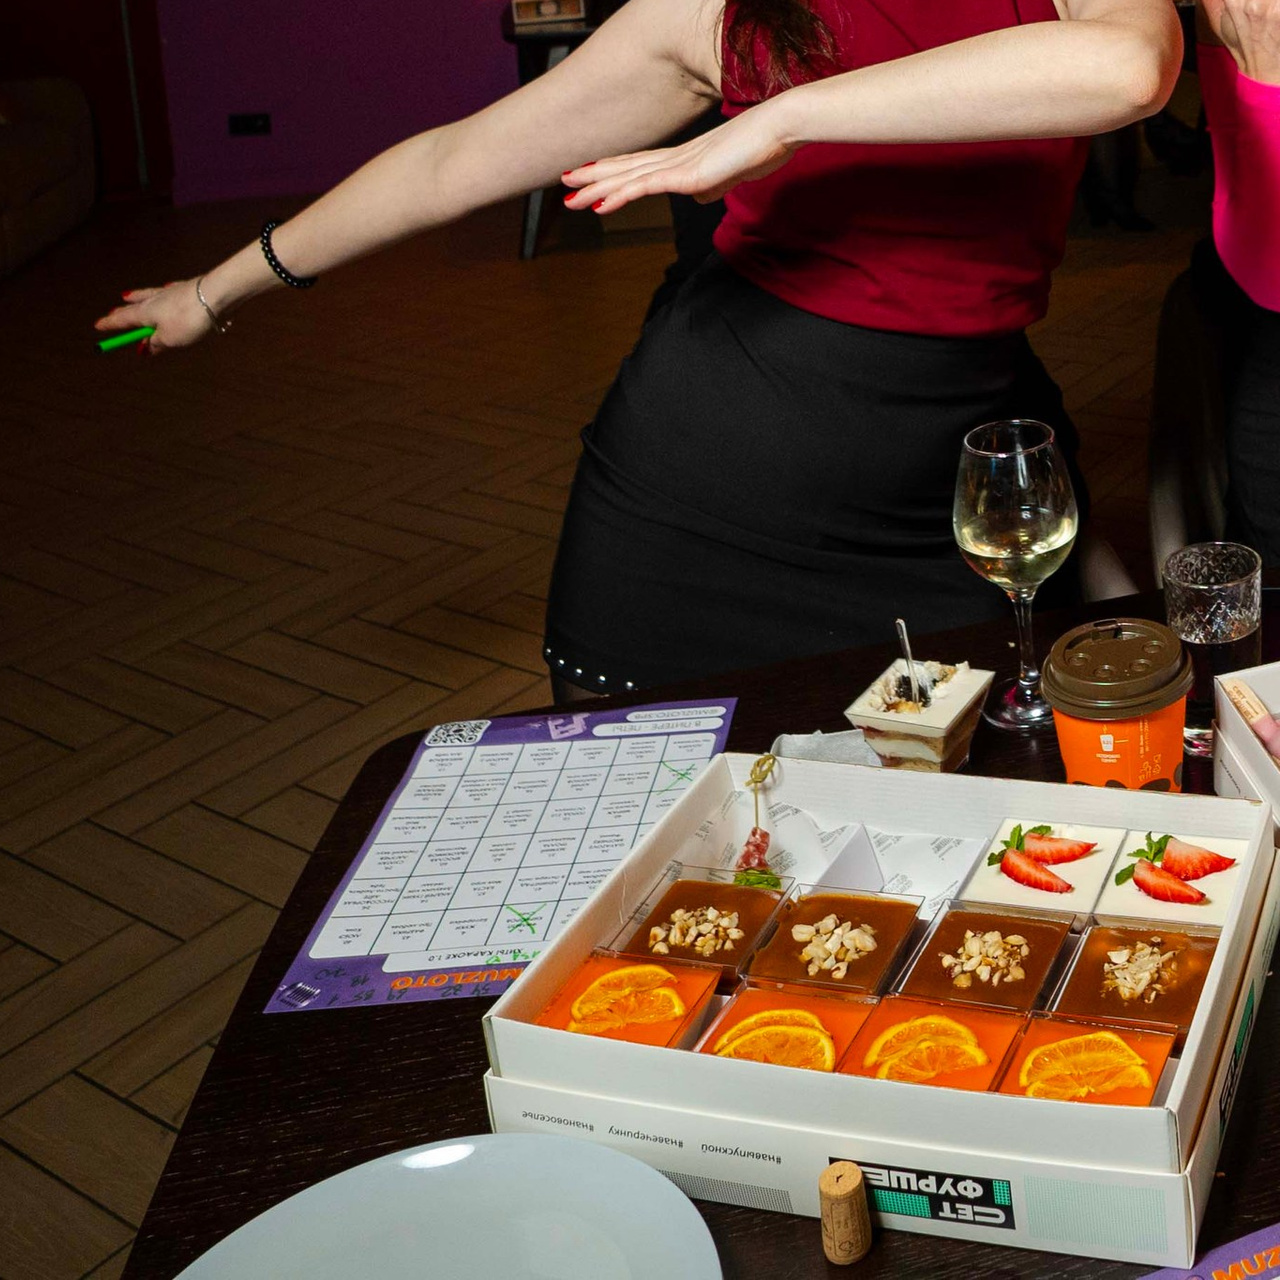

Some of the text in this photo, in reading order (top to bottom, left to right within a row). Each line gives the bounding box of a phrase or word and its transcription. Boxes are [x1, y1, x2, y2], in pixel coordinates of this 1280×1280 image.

[428, 954, 443, 962] 1.0
[444, 949, 494, 960] КАРАОКЕ
[390, 967, 525, 990] MUZLOTO
[521, 1109, 782, 1165] #нановоселье #навечеринку #навыпускной
[857, 1165, 984, 1199] ФУРШЕ
[938, 1200, 1006, 1225] СЕТ
